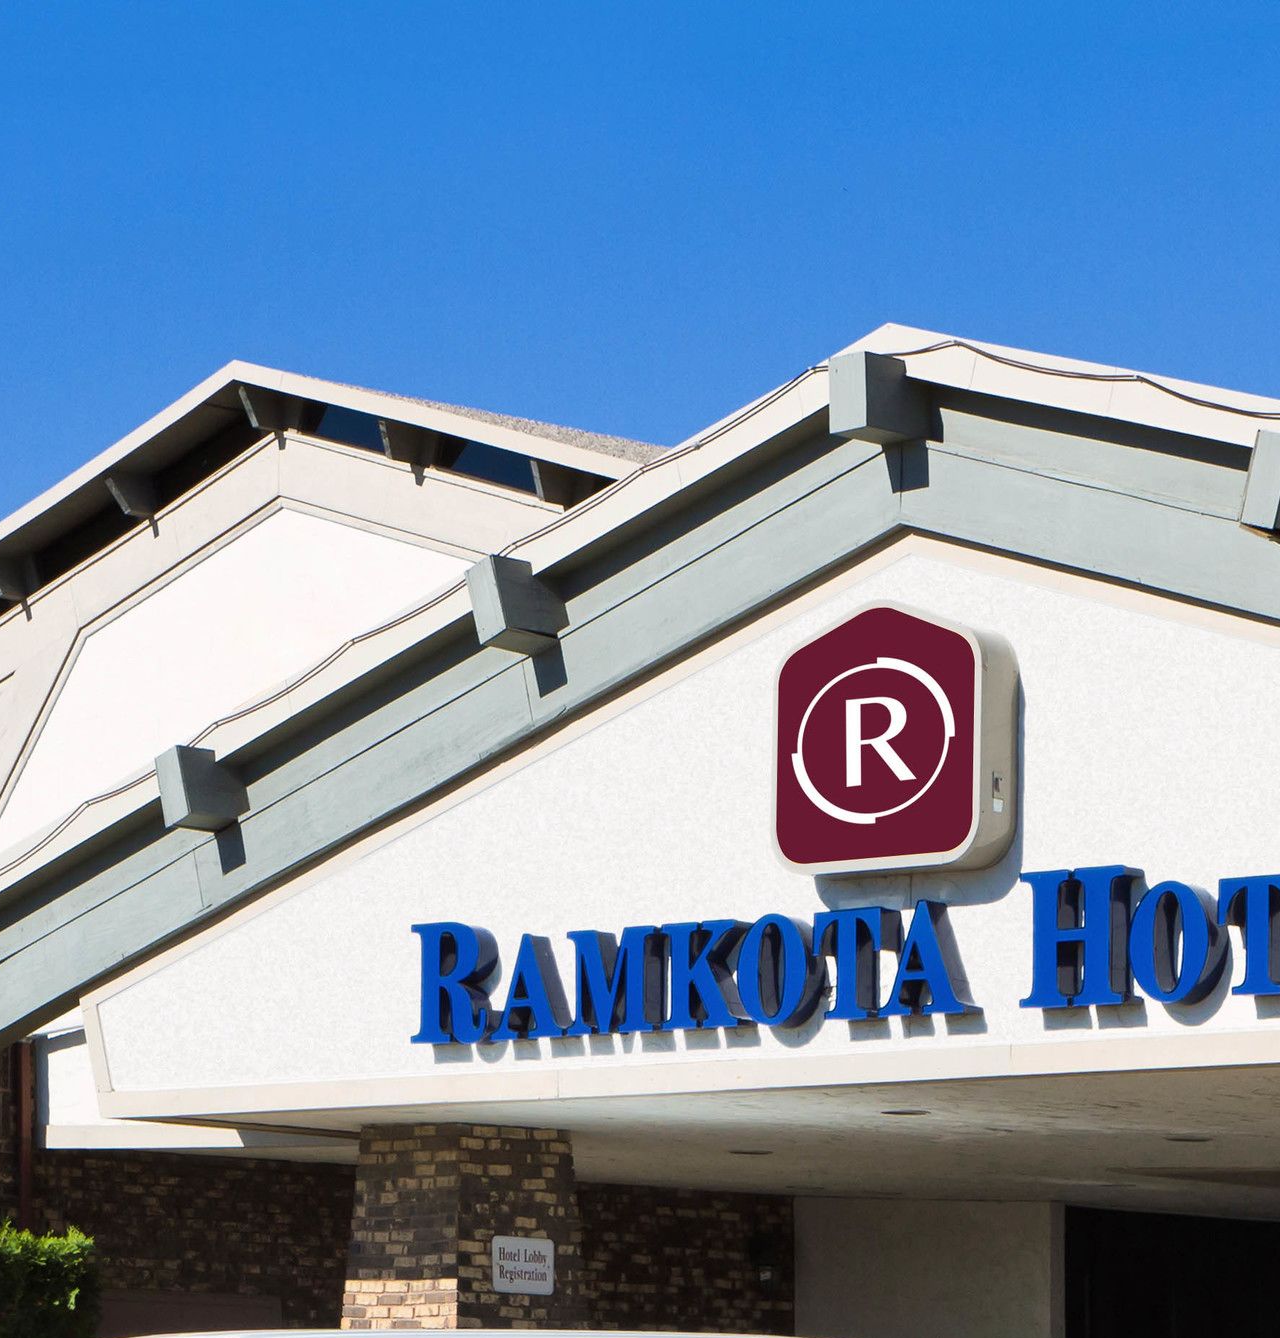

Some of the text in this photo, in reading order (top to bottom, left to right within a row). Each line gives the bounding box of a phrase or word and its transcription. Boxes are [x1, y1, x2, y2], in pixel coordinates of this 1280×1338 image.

[409, 899, 970, 1047] RAMKOTA
[498, 1246, 548, 1267] Hotel Lobby
[499, 1264, 548, 1283] Registration
